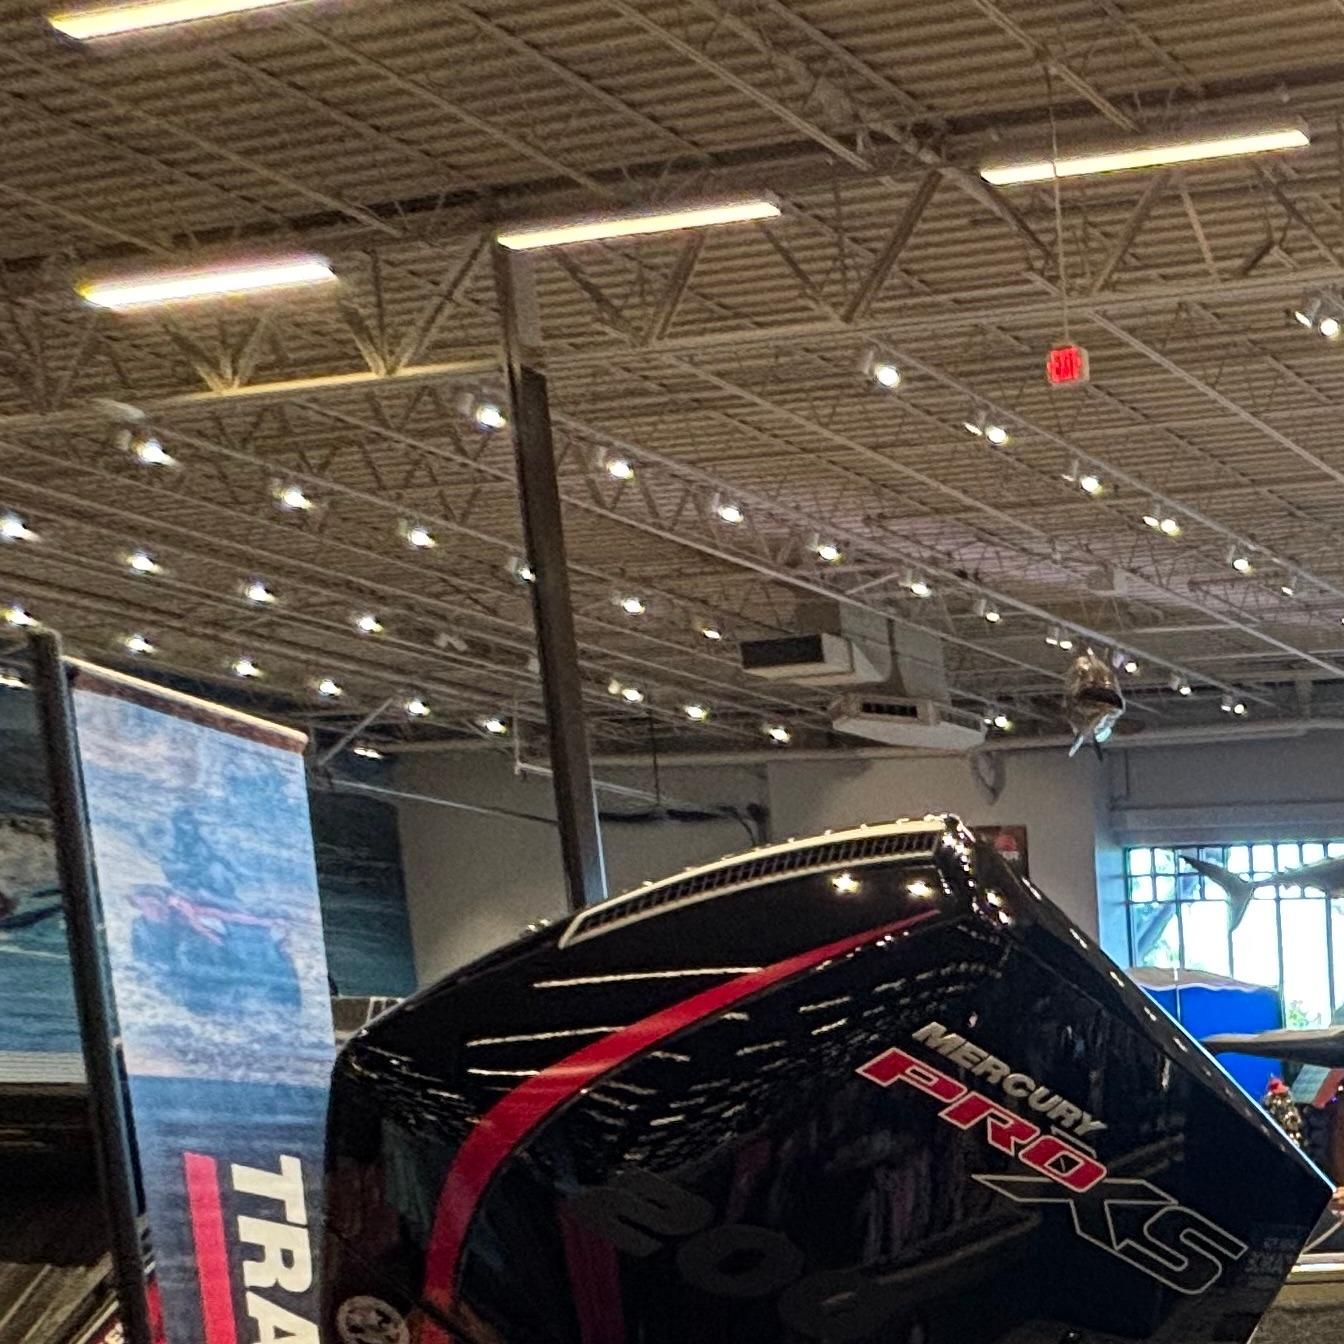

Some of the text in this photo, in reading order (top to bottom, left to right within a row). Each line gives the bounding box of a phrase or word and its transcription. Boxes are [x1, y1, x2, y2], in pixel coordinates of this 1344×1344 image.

[855, 1047, 1107, 1193] PRO
[912, 1021, 1107, 1136] MERCURY
[970, 1173, 1249, 1295] XS
